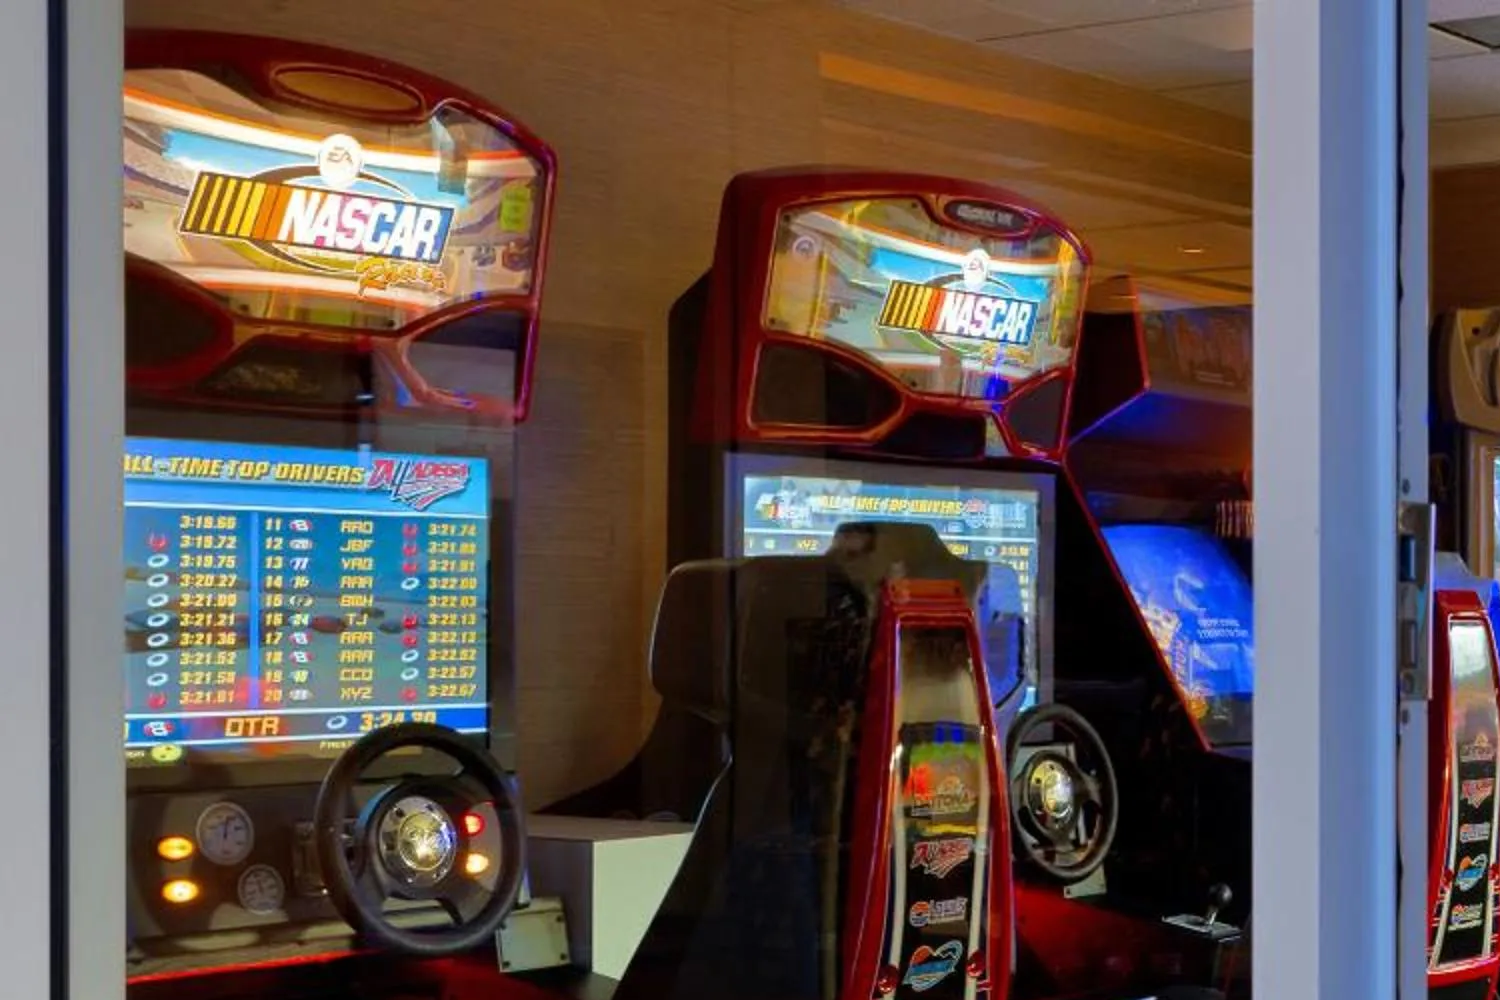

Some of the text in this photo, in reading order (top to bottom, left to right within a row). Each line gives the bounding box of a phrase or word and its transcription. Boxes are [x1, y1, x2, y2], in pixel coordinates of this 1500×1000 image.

[277, 187, 442, 260] NASCAR
[936, 288, 1032, 344] NASCAR
[226, 460, 271, 481] TOP
[275, 463, 365, 485] DRIVERS
[264, 519, 283, 531] 11
[264, 538, 283, 550] 12
[264, 557, 283, 568] 13
[264, 576, 283, 588] 14
[264, 595, 283, 607] 15
[264, 614, 283, 626] 16
[264, 633, 283, 644] 17
[264, 652, 283, 663] 18
[264, 671, 283, 683] 19
[264, 690, 283, 702] 20
